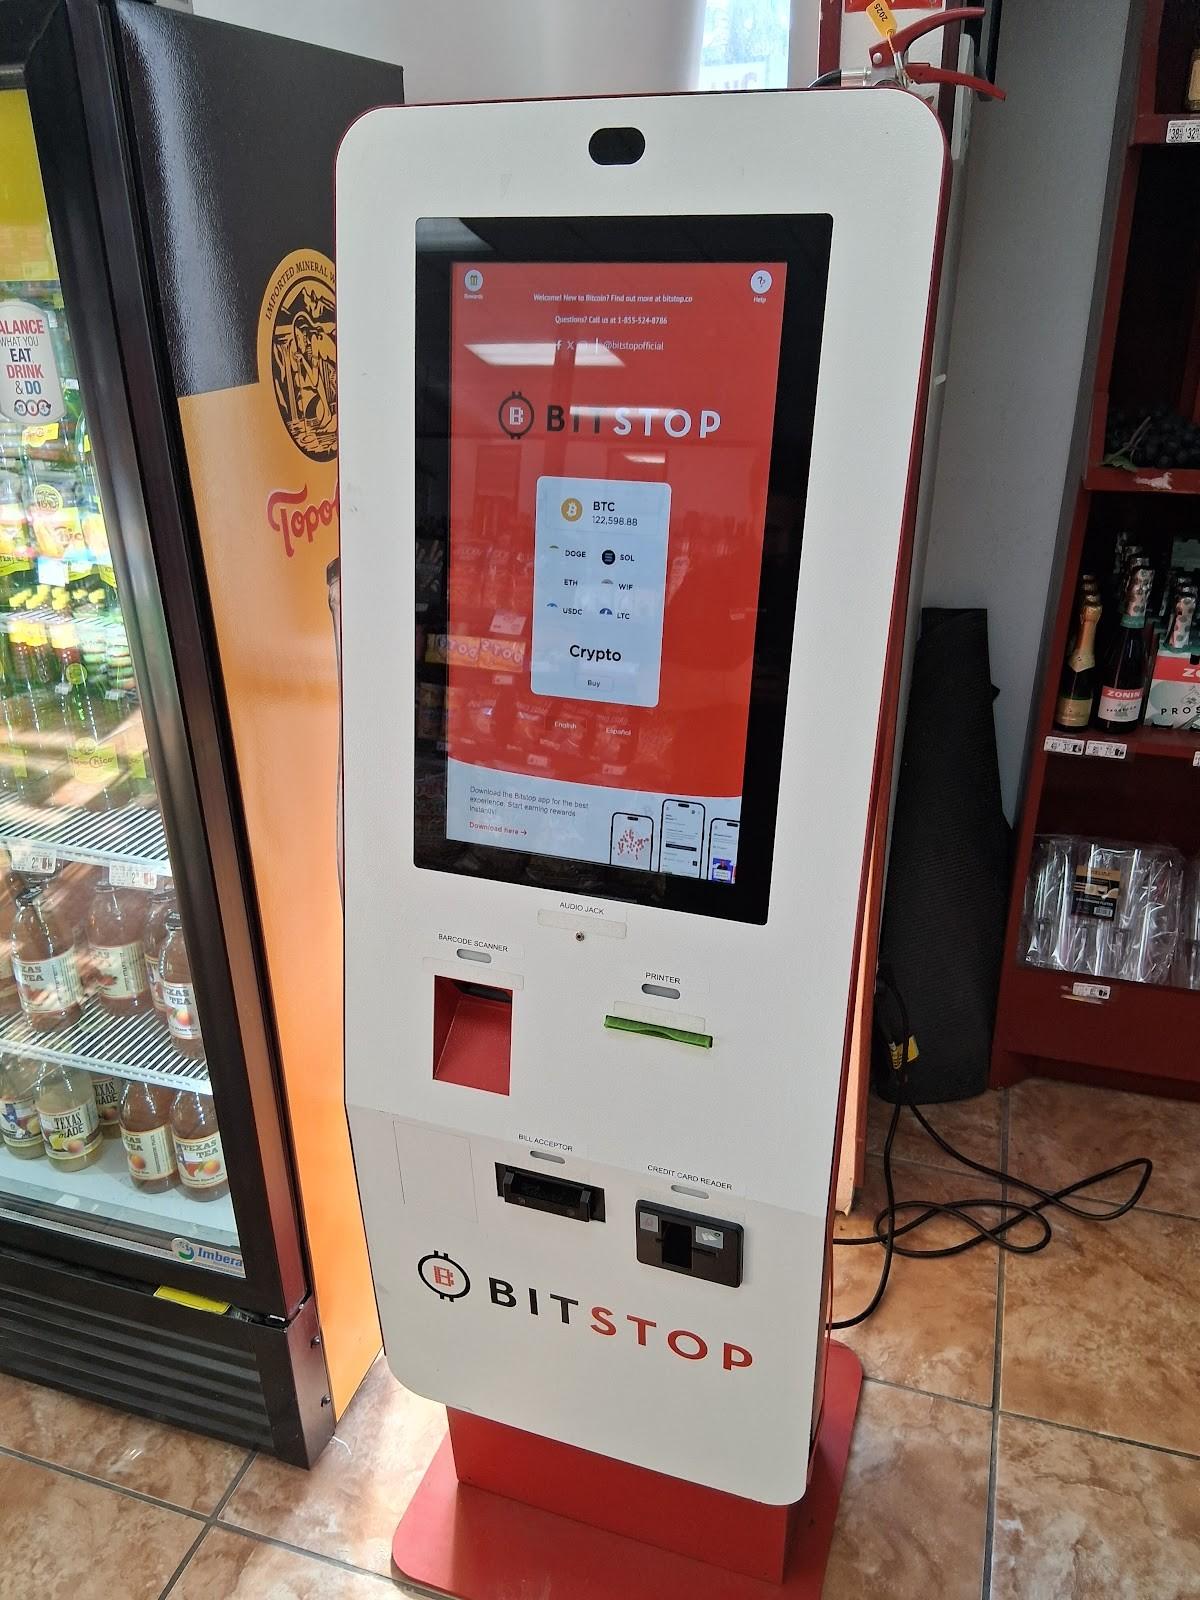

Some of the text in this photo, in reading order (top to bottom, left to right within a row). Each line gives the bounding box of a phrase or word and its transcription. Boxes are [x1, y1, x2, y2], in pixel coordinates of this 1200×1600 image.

[874, 3, 888, 22] 2025
[265, 260, 328, 320] IMPORTED MINERAL
[533, 293, 562, 302] Welcome!
[563, 294, 578, 302] New
[586, 294, 610, 302] Bitcoin?
[662, 295, 693, 304] bitstop.co
[555, 316, 588, 324] Questions?
[588, 316, 600, 324] Call
[0, 335, 39, 347] WHAT YOU
[603, 340, 664, 351] @bitstopofficial
[6, 364, 44, 379] DRINK
[16, 380, 42, 394] & DO
[546, 404, 721, 438] BITSTOP
[593, 501, 615, 512] BTC
[592, 515, 638, 526] 122,598.88
[565, 550, 635, 562] DOGE SOL
[564, 578, 578, 586] ETH
[562, 608, 630, 620] USDC LTC
[570, 644, 622, 662] Crypto
[587, 680, 600, 688] Buy
[1107, 690, 1140, 698] ZONIN
[554, 721, 577, 730] English
[470, 786, 501, 797] Download
[514, 792, 536, 802] Bitstop
[574, 800, 589, 809] best
[508, 802, 523, 810] Start
[524, 805, 548, 814] earning
[550, 808, 576, 817] rewards
[470, 822, 518, 835] Download here
[560, 902, 605, 915] AUDIO JACK
[438, 933, 508, 952] BARCODE SCANNER
[22, 974, 44, 982] TEA
[646, 972, 681, 985] PRINTER
[169, 996, 192, 1005] TEA
[93, 1081, 115, 1097] EXAS
[54, 1111, 82, 1130] TEXAS
[127, 1142, 144, 1152] TEA
[183, 1139, 217, 1152] TEXAS
[518, 1133, 573, 1152] BILL ACCEPTOR
[196, 1148, 218, 1158] TEA
[647, 1164, 732, 1191] CREDIT CARD READER
[197, 1247, 242, 1267] Imbera
[488, 1276, 753, 1371] BITSTOP
